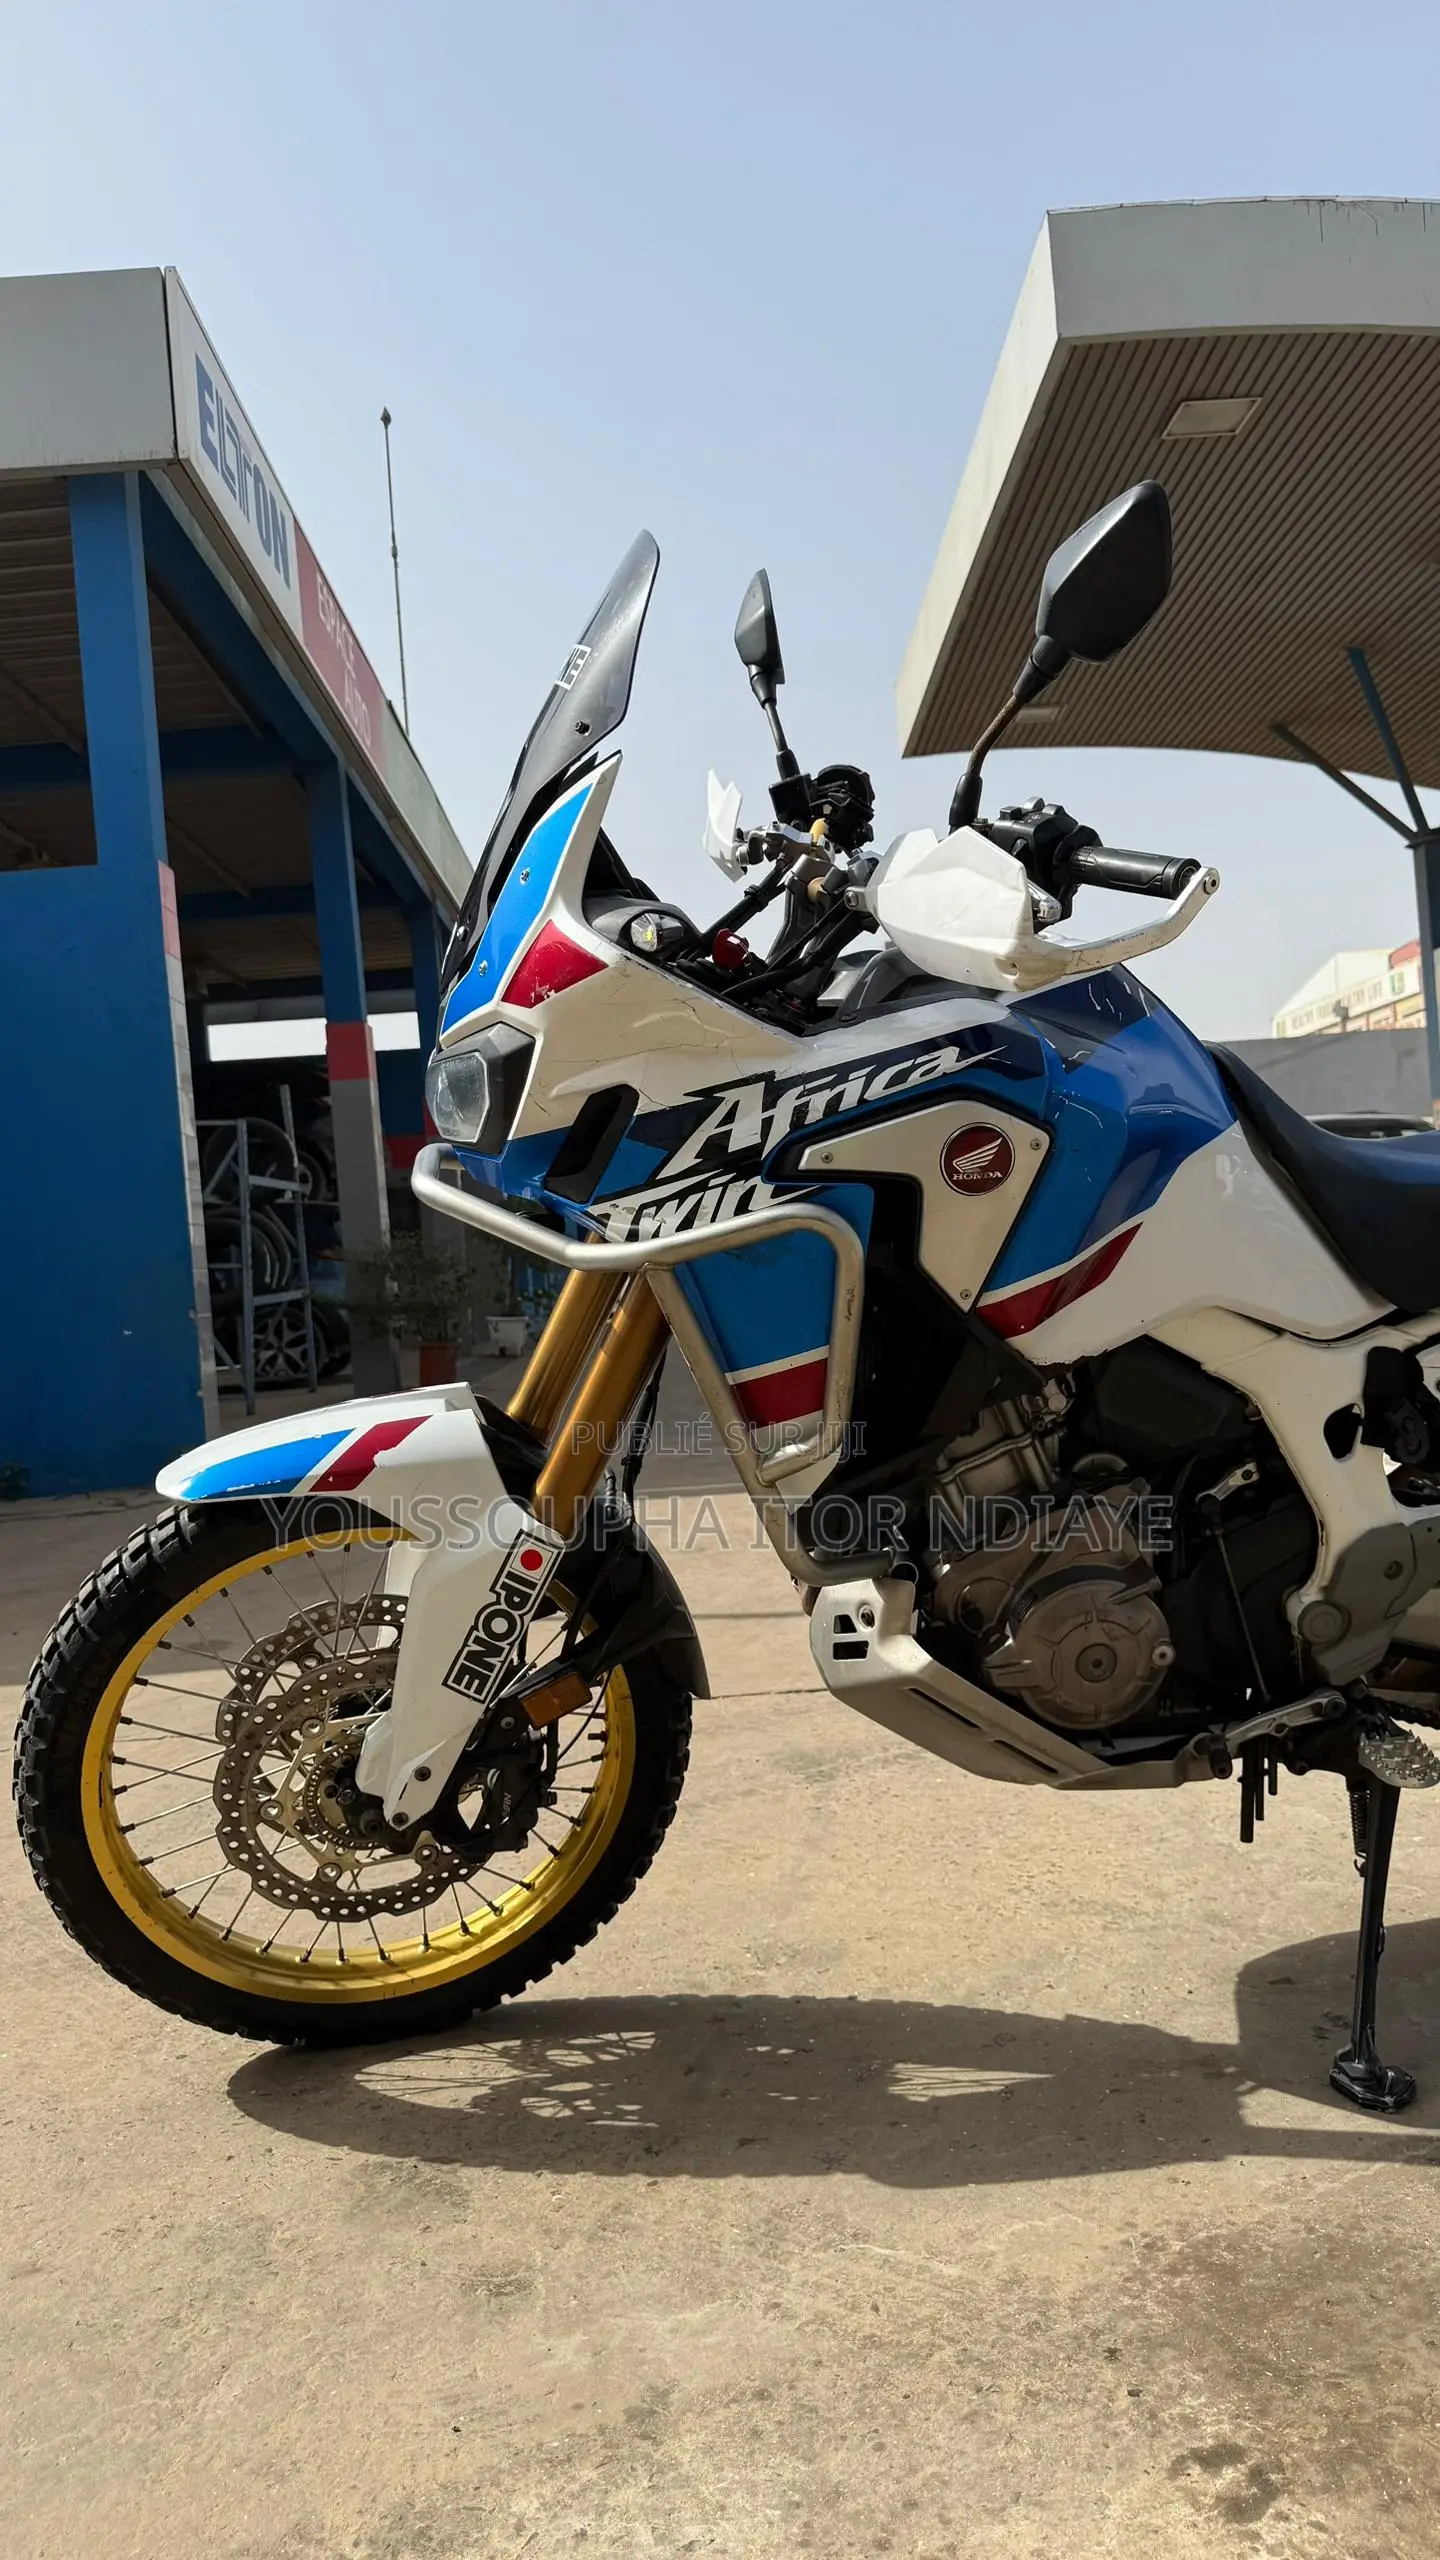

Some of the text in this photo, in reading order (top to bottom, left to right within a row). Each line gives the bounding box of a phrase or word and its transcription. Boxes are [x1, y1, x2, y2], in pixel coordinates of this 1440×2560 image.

[316, 573, 357, 680] ESPACE
[344, 670, 371, 748] AUTO
[656, 1045, 1008, 1180] Africa
[586, 1168, 822, 1243] Twin
[952, 1171, 1003, 1180] HONDA
[449, 1569, 540, 1699] IPONE
